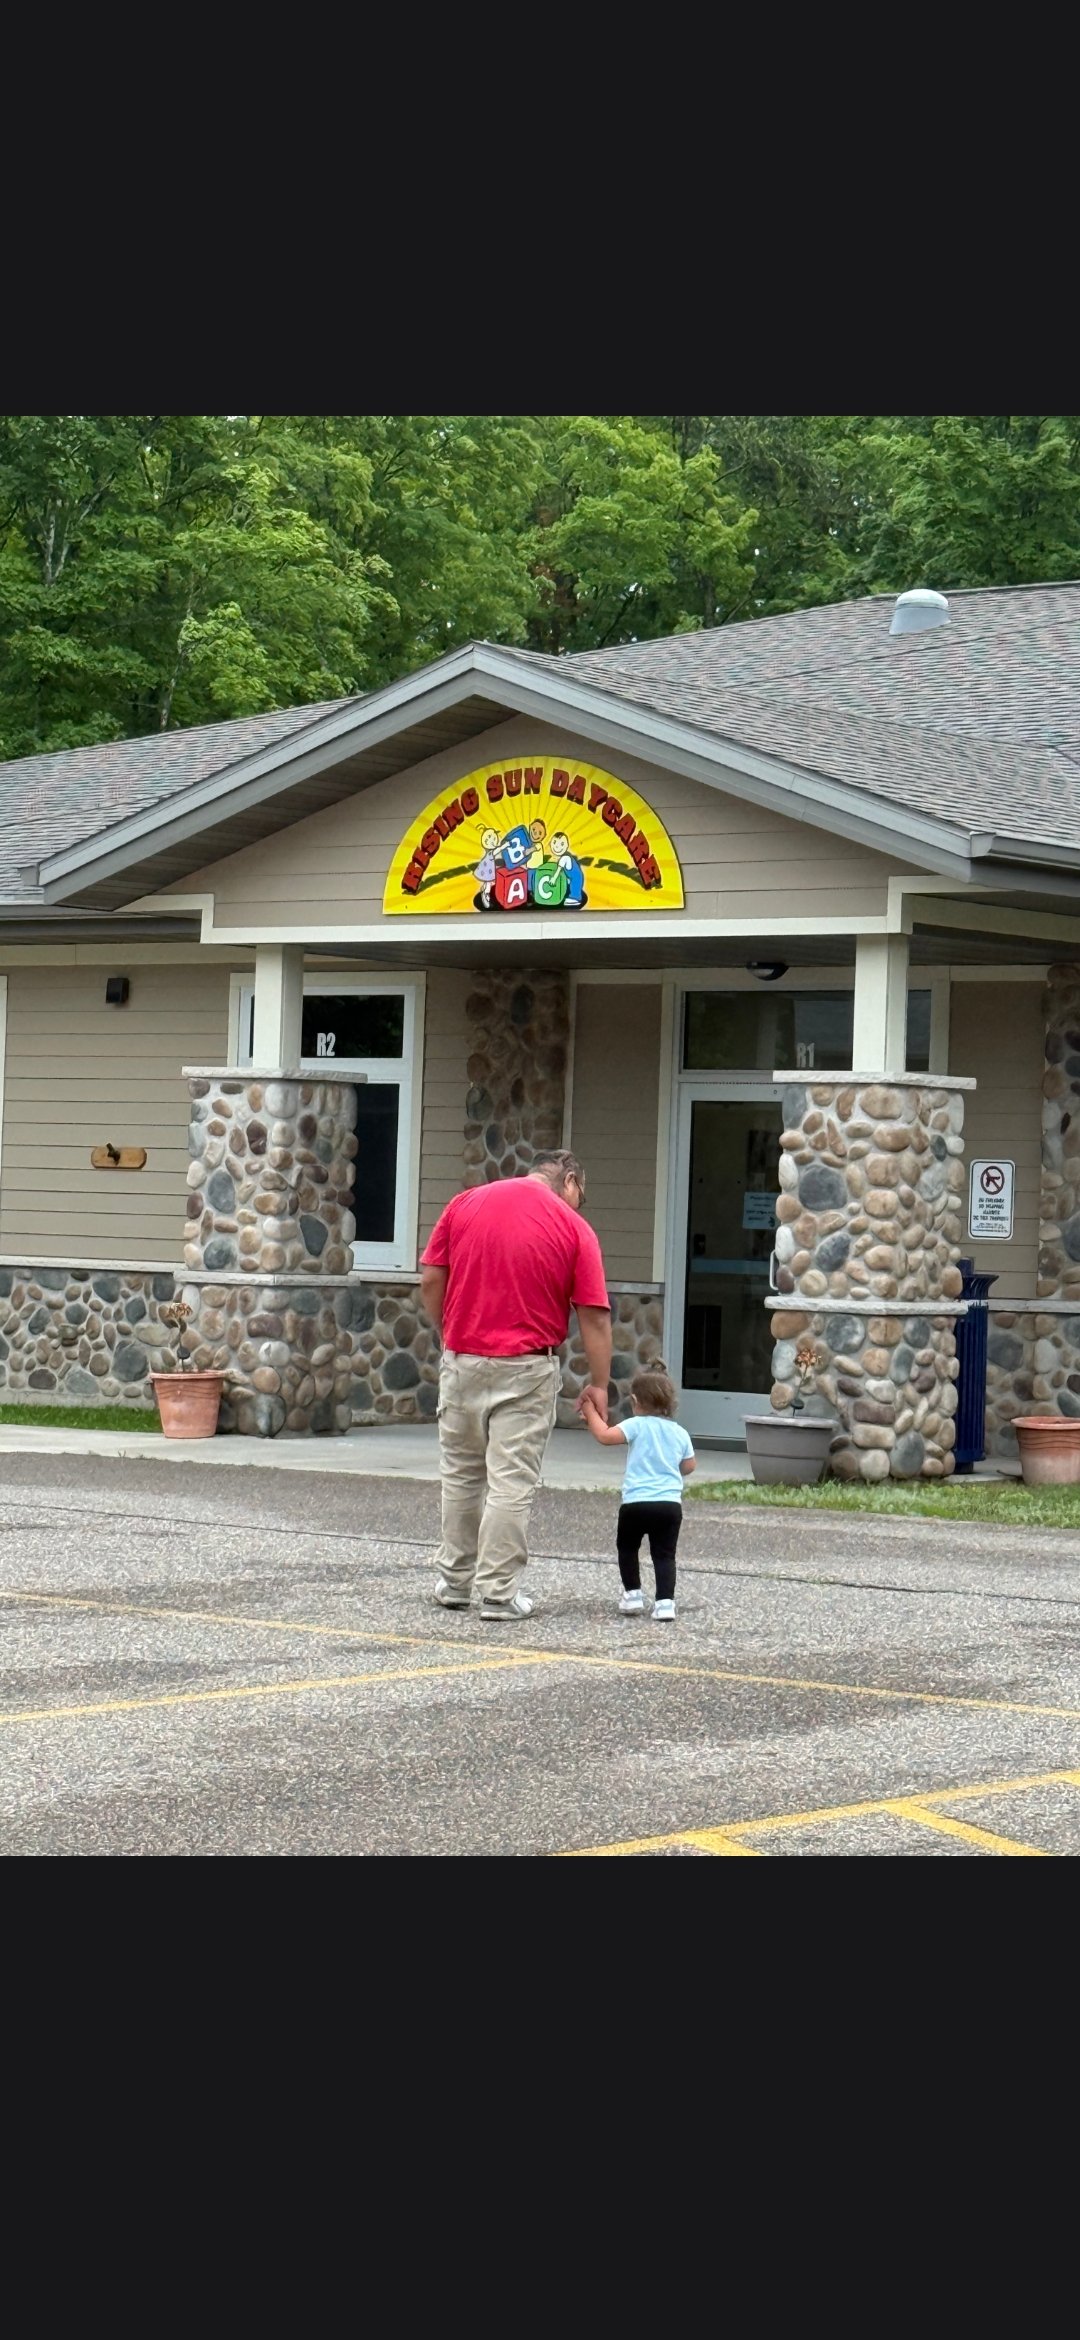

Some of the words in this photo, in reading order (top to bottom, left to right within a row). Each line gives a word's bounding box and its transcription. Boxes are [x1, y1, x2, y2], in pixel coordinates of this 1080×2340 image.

[401, 786, 480, 894] RISING
[486, 766, 544, 803] SUN
[550, 768, 662, 890] DAYCARE
[507, 837, 526, 864] B
[507, 878, 525, 903] A
[538, 875, 553, 900] C
[316, 1032, 336, 1057] R2
[796, 1042, 815, 1068] R1
